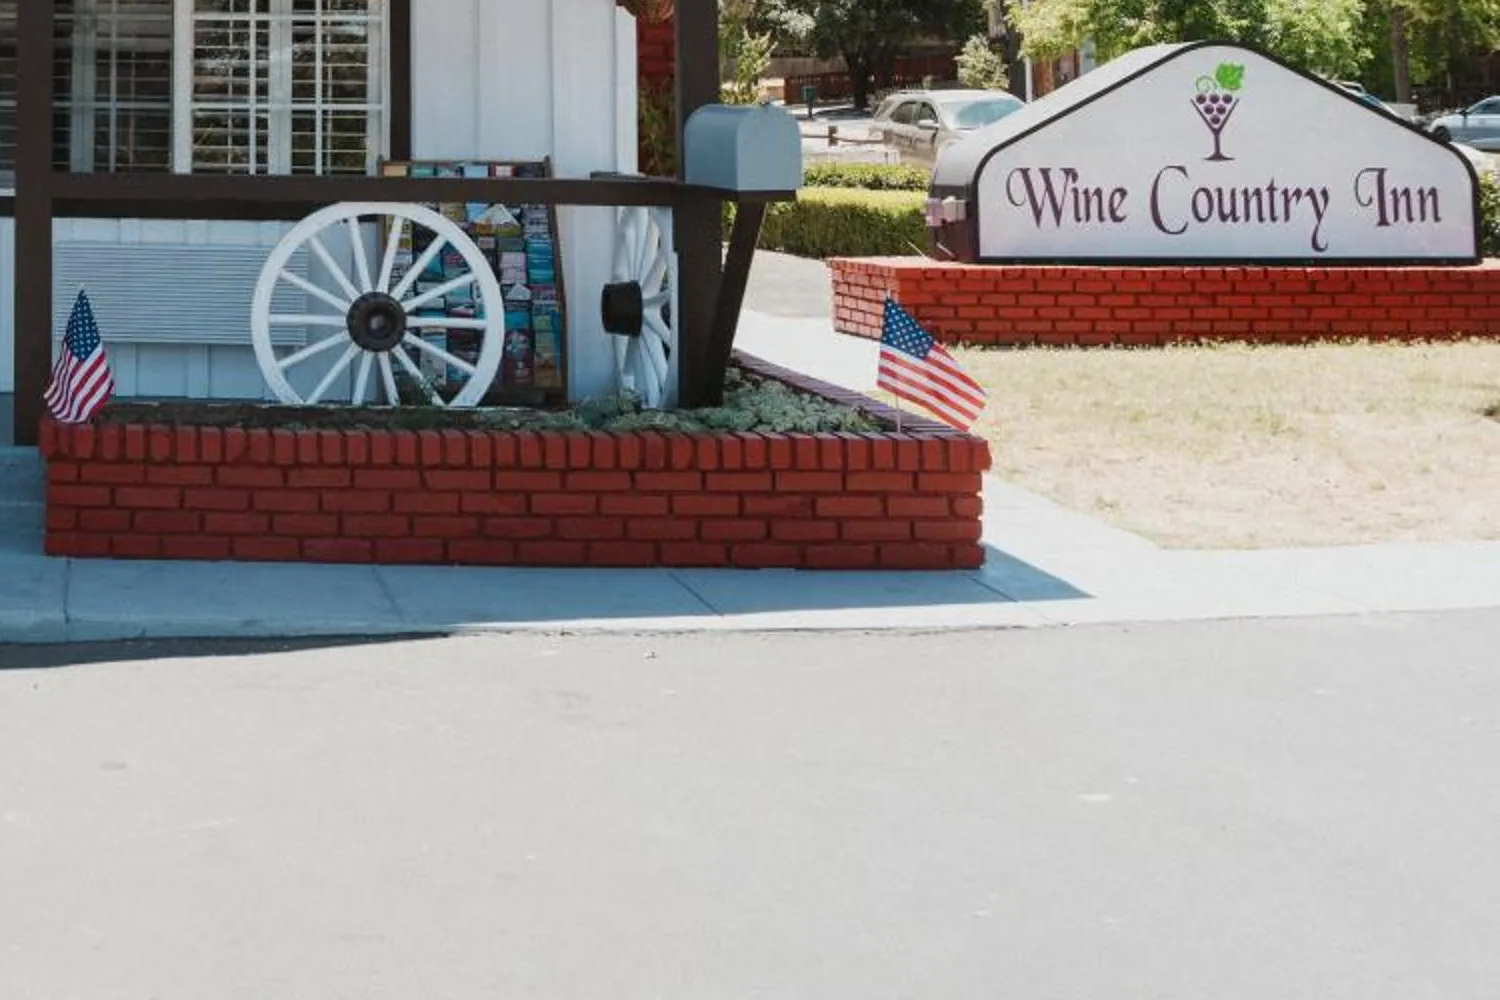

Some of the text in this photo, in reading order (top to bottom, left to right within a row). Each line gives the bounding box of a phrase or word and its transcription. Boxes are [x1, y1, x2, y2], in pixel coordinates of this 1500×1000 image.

[1005, 165, 1442, 253] Wine Country Inn
